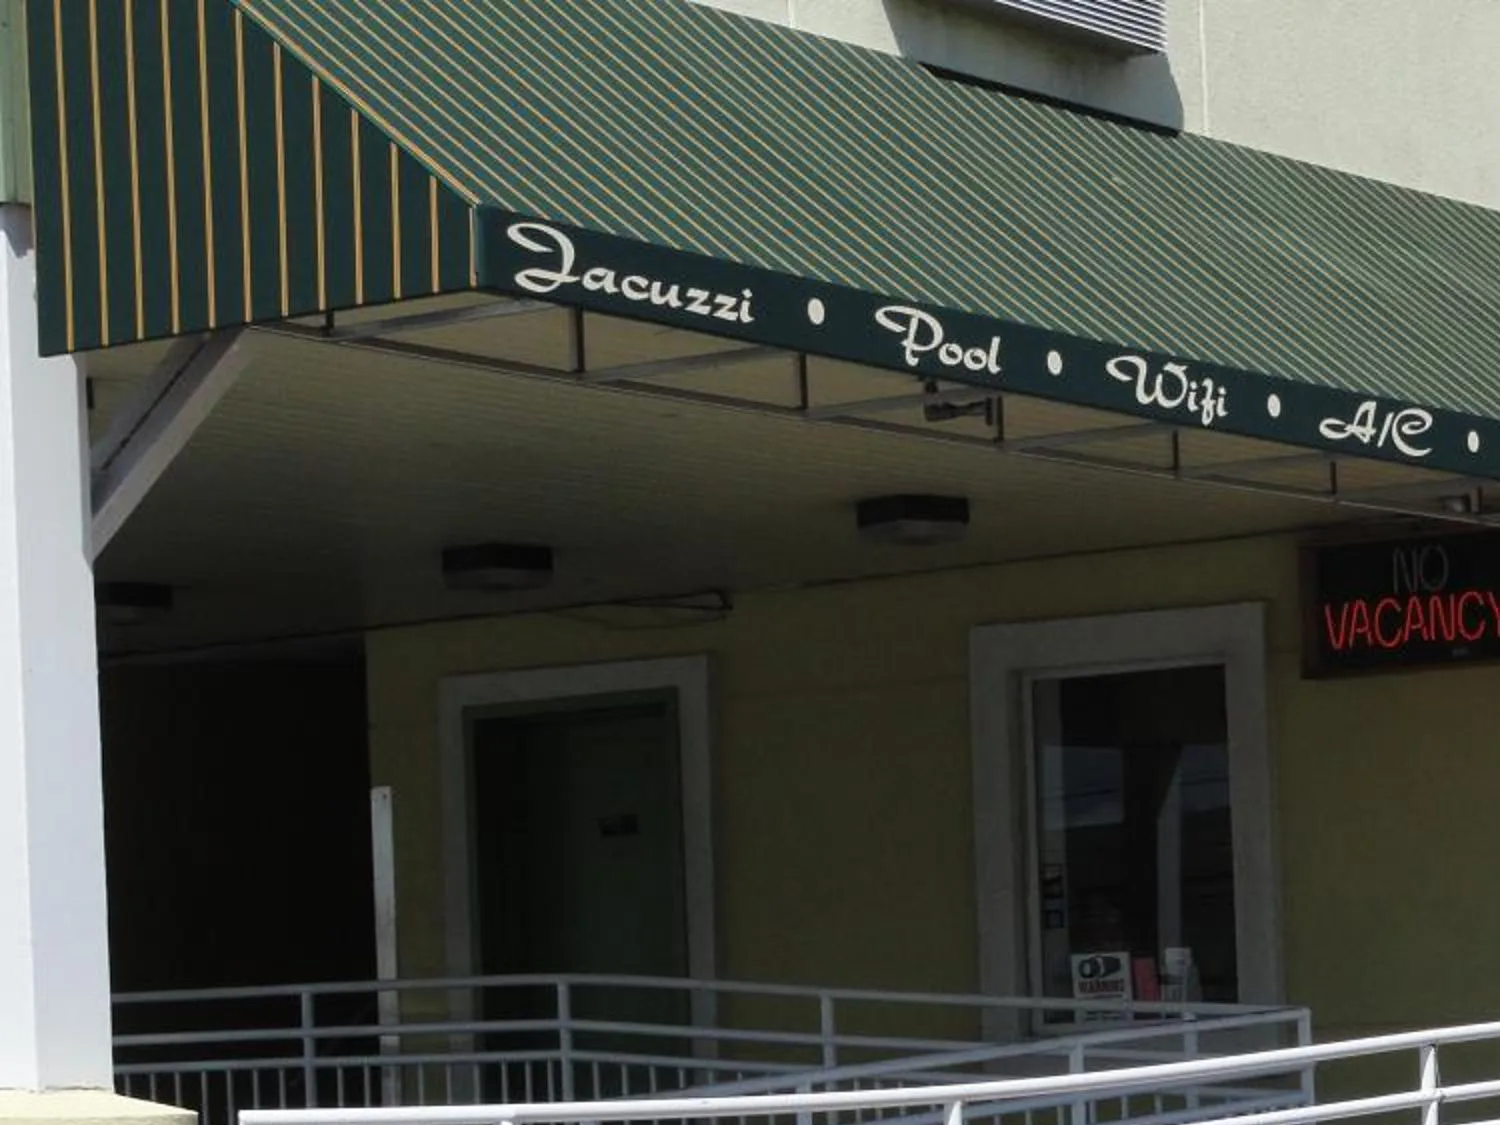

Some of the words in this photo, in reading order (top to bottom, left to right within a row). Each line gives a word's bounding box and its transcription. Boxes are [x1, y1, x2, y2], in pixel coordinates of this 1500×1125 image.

[506, 222, 754, 324] Jacuzzi
[874, 304, 1002, 375] Pool
[1105, 354, 1228, 426] Wifi
[1318, 400, 1434, 458] A/C
[1393, 544, 1449, 592] NO
